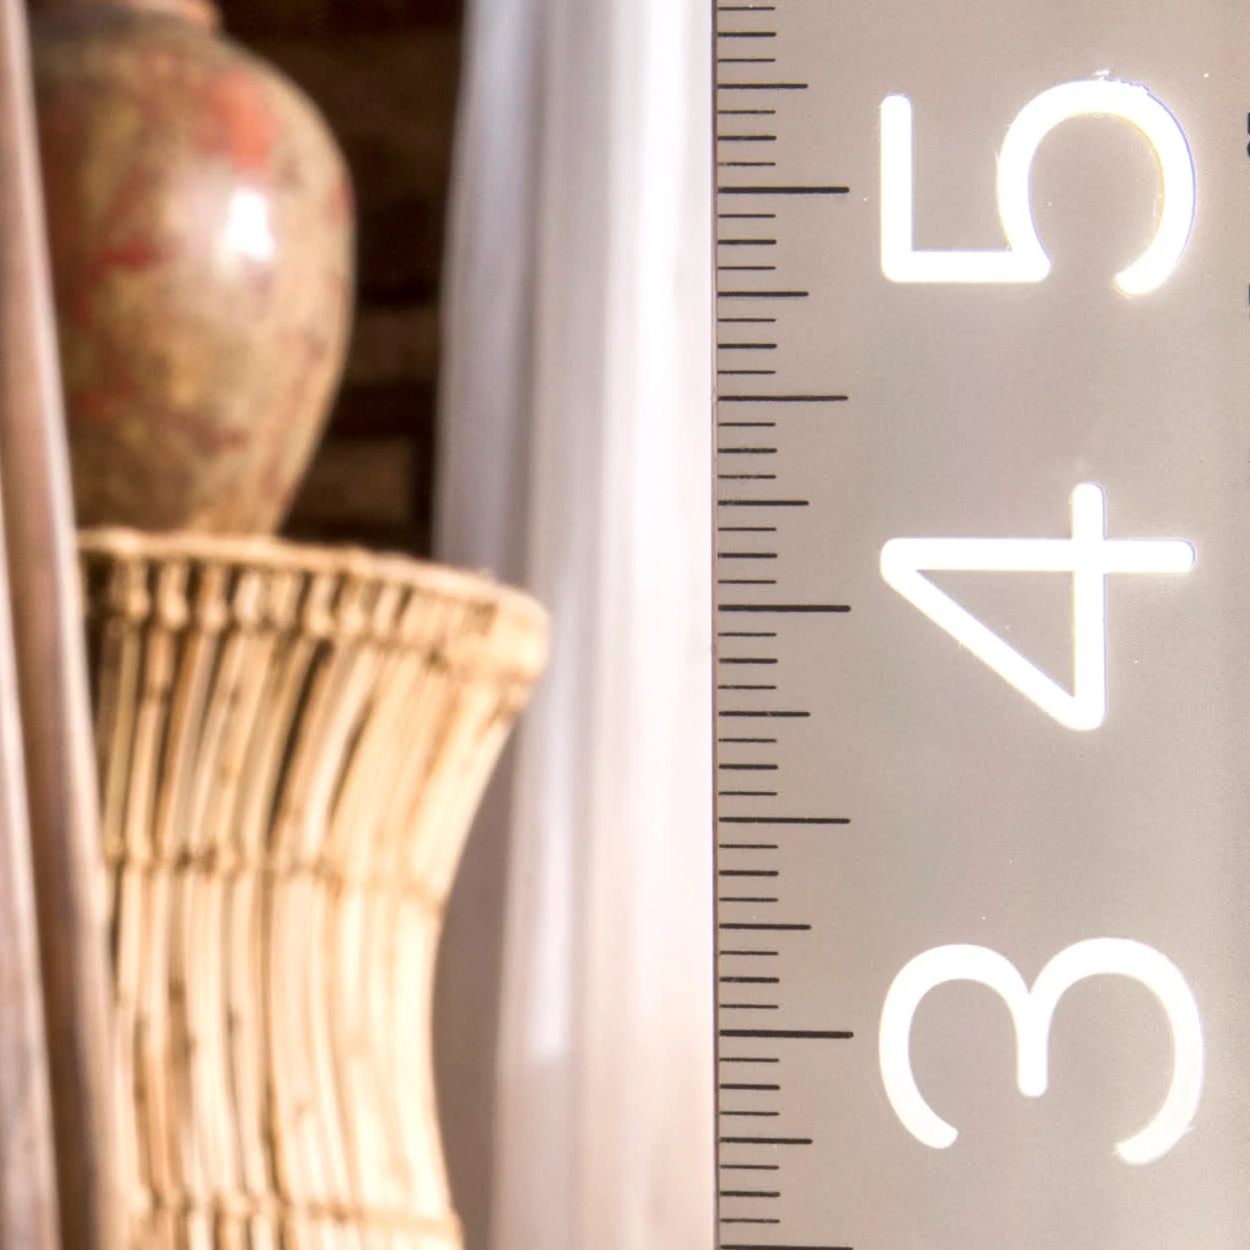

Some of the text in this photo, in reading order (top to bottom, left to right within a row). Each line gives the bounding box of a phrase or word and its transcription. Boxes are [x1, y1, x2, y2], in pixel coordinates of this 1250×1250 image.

[880, 77, 1196, 295] 5
[880, 482, 1196, 730] 4
[879, 937, 1205, 1165] 3
